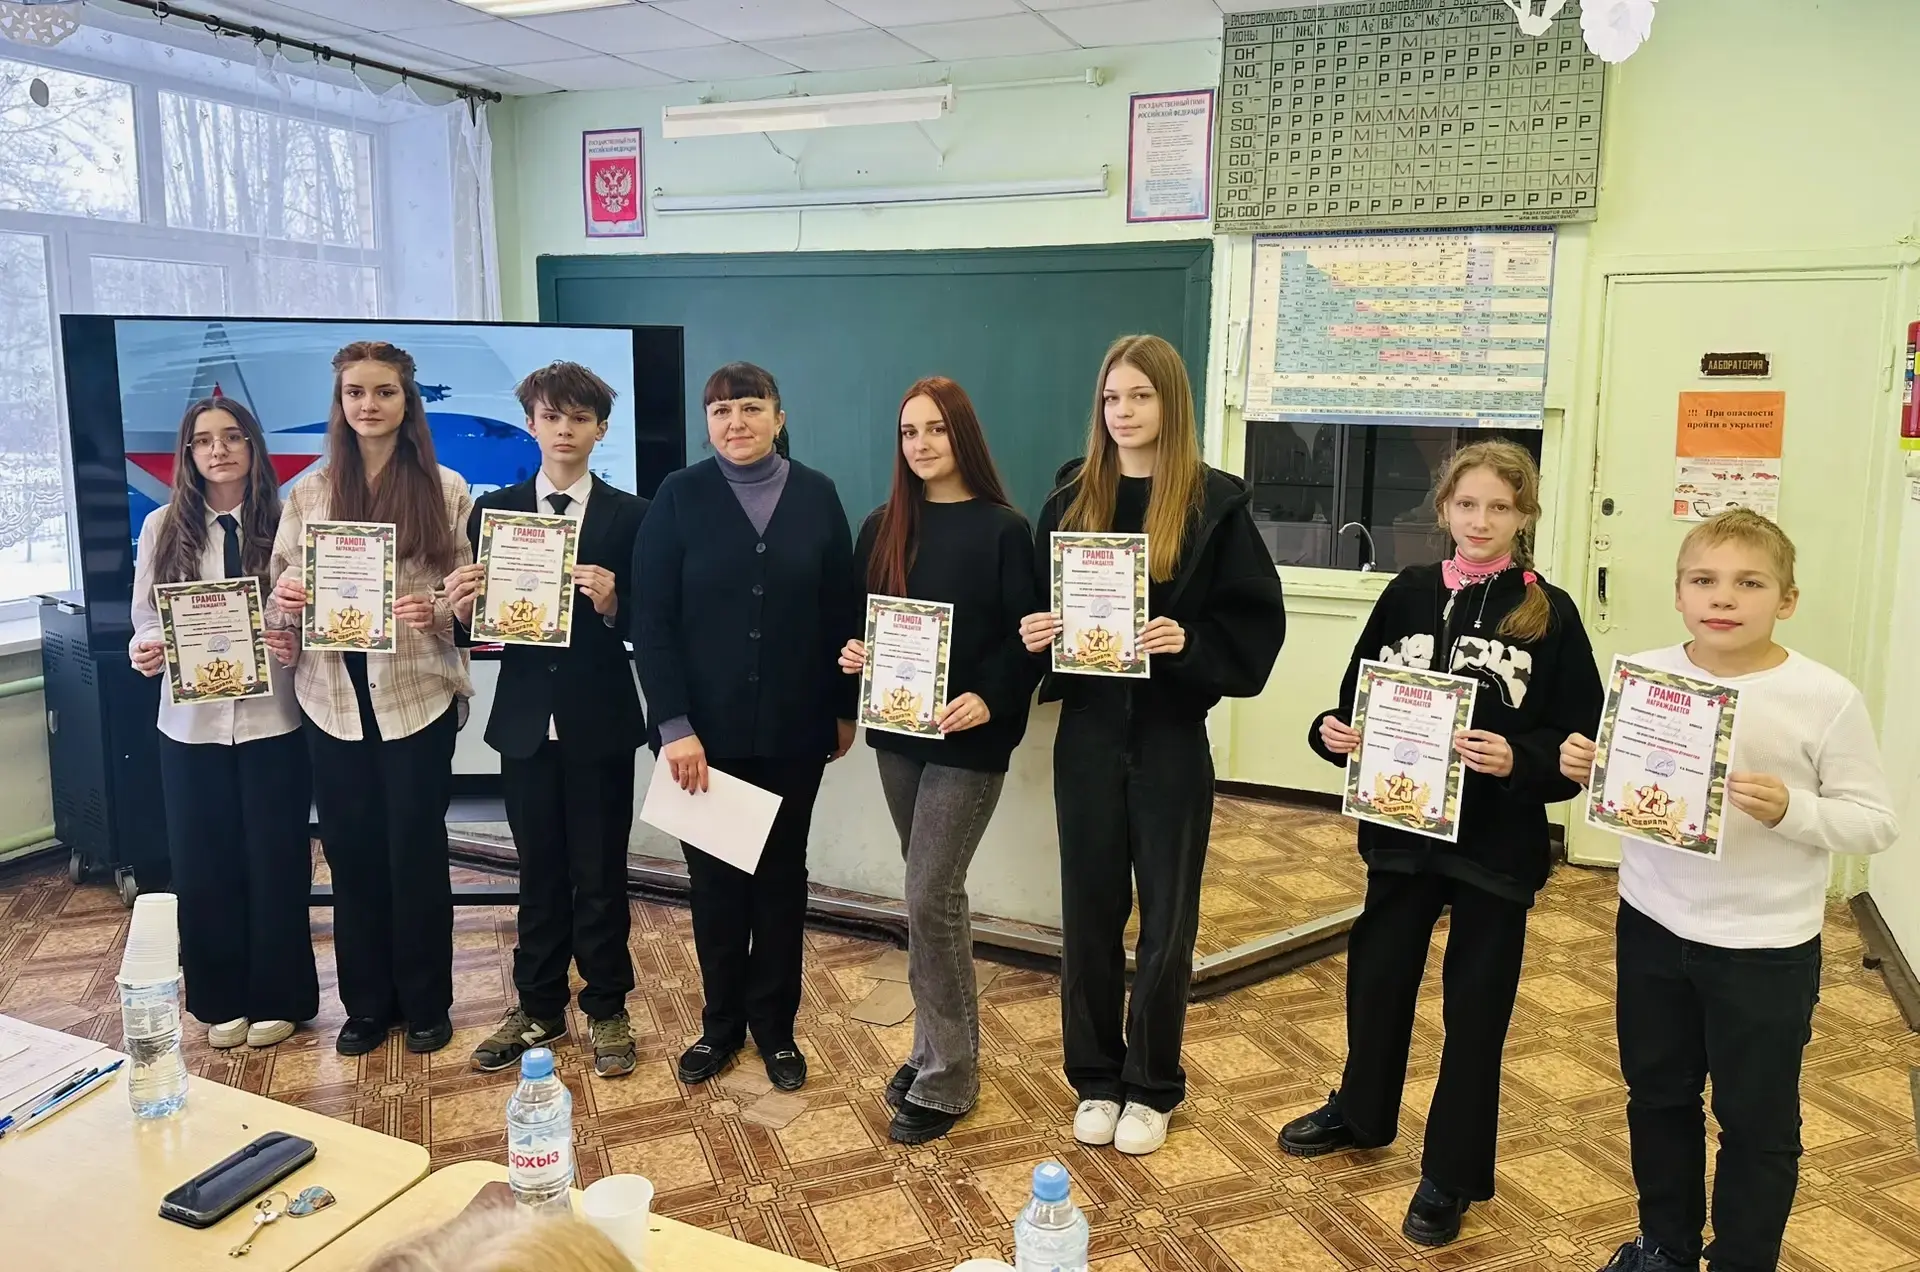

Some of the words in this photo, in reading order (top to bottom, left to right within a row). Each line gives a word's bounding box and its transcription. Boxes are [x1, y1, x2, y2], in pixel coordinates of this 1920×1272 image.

[1231, 11, 1298, 26] РАСТВОРИМОСТЬ
[1334, 4, 1367, 16] КИСЛОТ
[1232, 30, 1258, 42] ИОНЫ
[1138, 109, 1172, 118] РОССИЙСКОЙ
[1708, 360, 1763, 370] ЛАБОРАТОРИЯ
[1706, 410, 1724, 418] При
[1687, 421, 1719, 429] пройти
[1730, 421, 1772, 429] укрытие!
[513, 528, 545, 537] ГРАМОТА
[336, 537, 366, 546] ГРАМОТА
[1083, 550, 1114, 560] ГРАМОТА
[192, 594, 226, 604] ГРАМОТА
[512, 600, 533, 622] 23
[342, 608, 361, 629] 23
[894, 614, 922, 625] ГРАМОТА
[1089, 628, 1110, 651] 23
[208, 660, 231, 681] 23
[893, 688, 912, 711] 23
[1394, 685, 1432, 701] ГРАМОТА
[1648, 686, 1691, 707] ГРАМОТА
[1646, 698, 1690, 715] НАГРАЖДАЕТСЯ
[1388, 775, 1414, 803] 23
[1639, 786, 1669, 817] 23
[1631, 818, 1668, 827] ФЕВРАЛЯ
